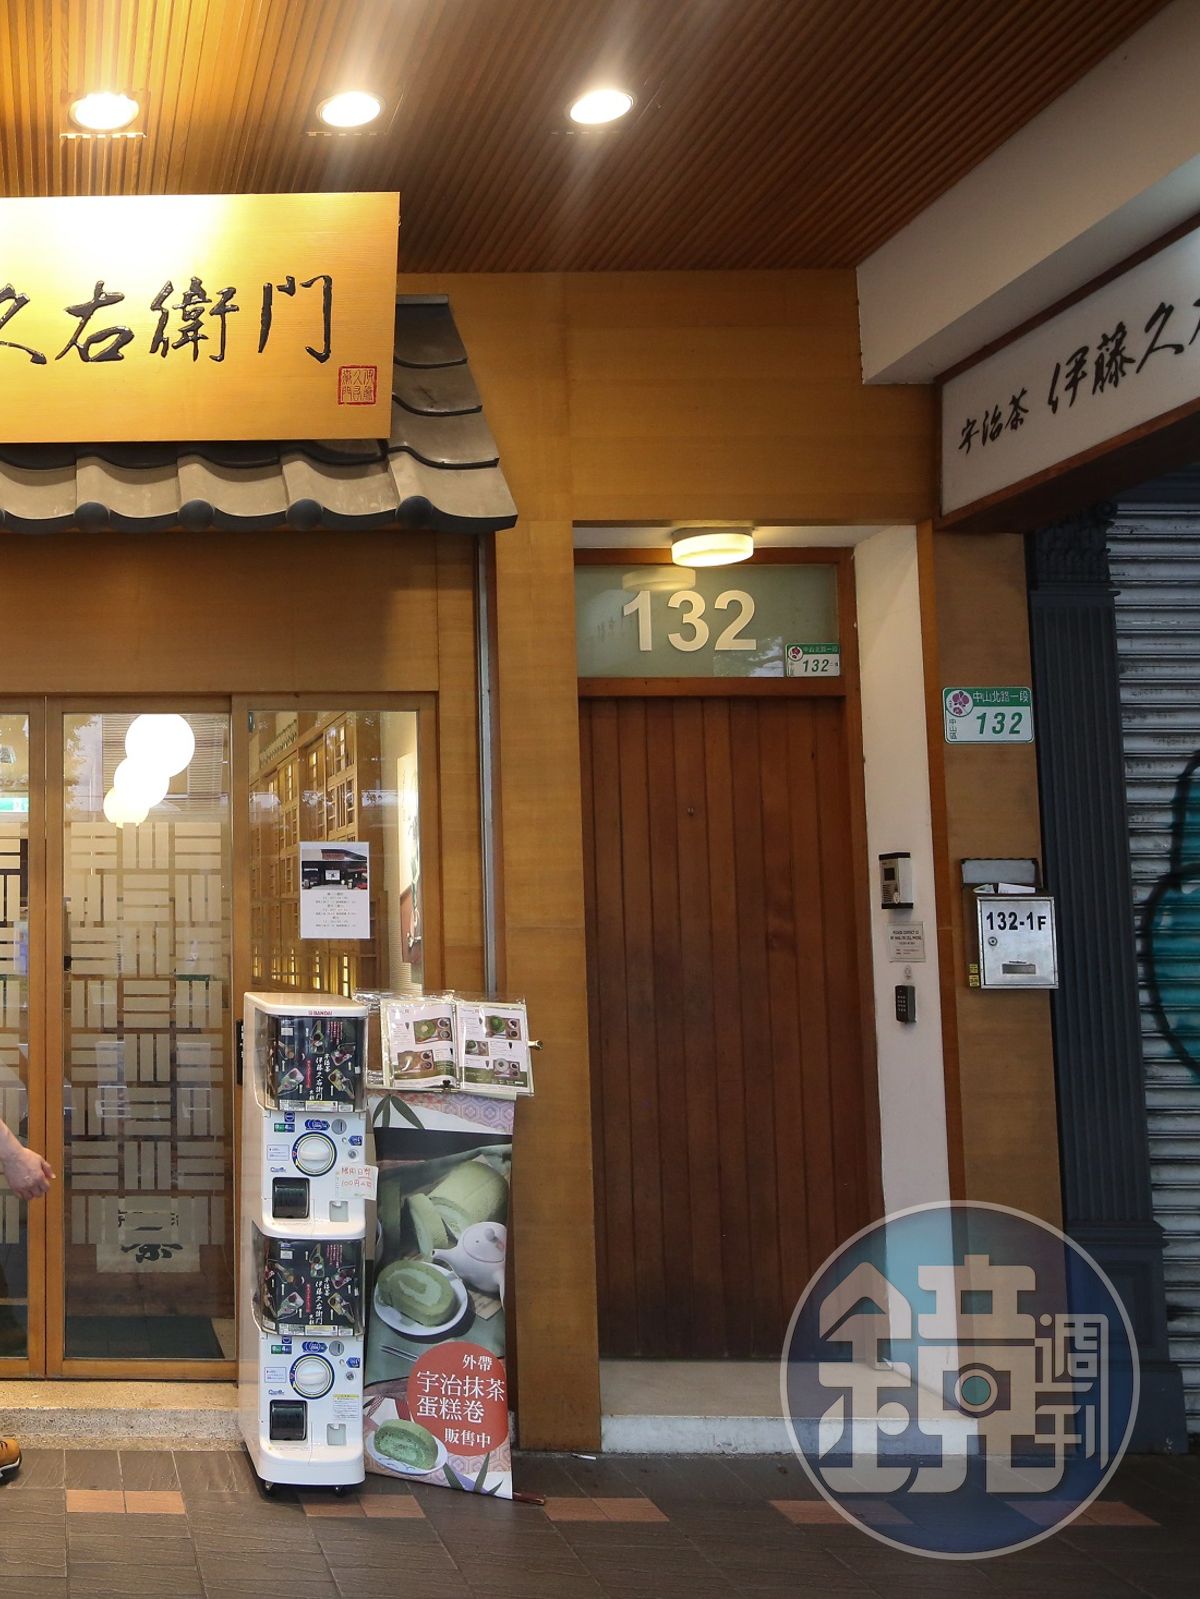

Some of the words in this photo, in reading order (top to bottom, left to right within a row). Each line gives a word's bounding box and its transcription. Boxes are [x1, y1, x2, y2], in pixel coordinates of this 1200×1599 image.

[958, 387, 1029, 455] 宇治茶
[622, 590, 757, 653] 132
[802, 658, 829, 673] 132
[973, 690, 1029, 703] 中山北路一段
[976, 711, 1023, 735] 132
[986, 911, 1047, 931] 132-1F
[462, 1354, 493, 1372] 外帶
[416, 1371, 506, 1402] 宇治抹茶
[416, 1395, 485, 1424] 蛋糕卷
[444, 1428, 492, 1449] 販售中
